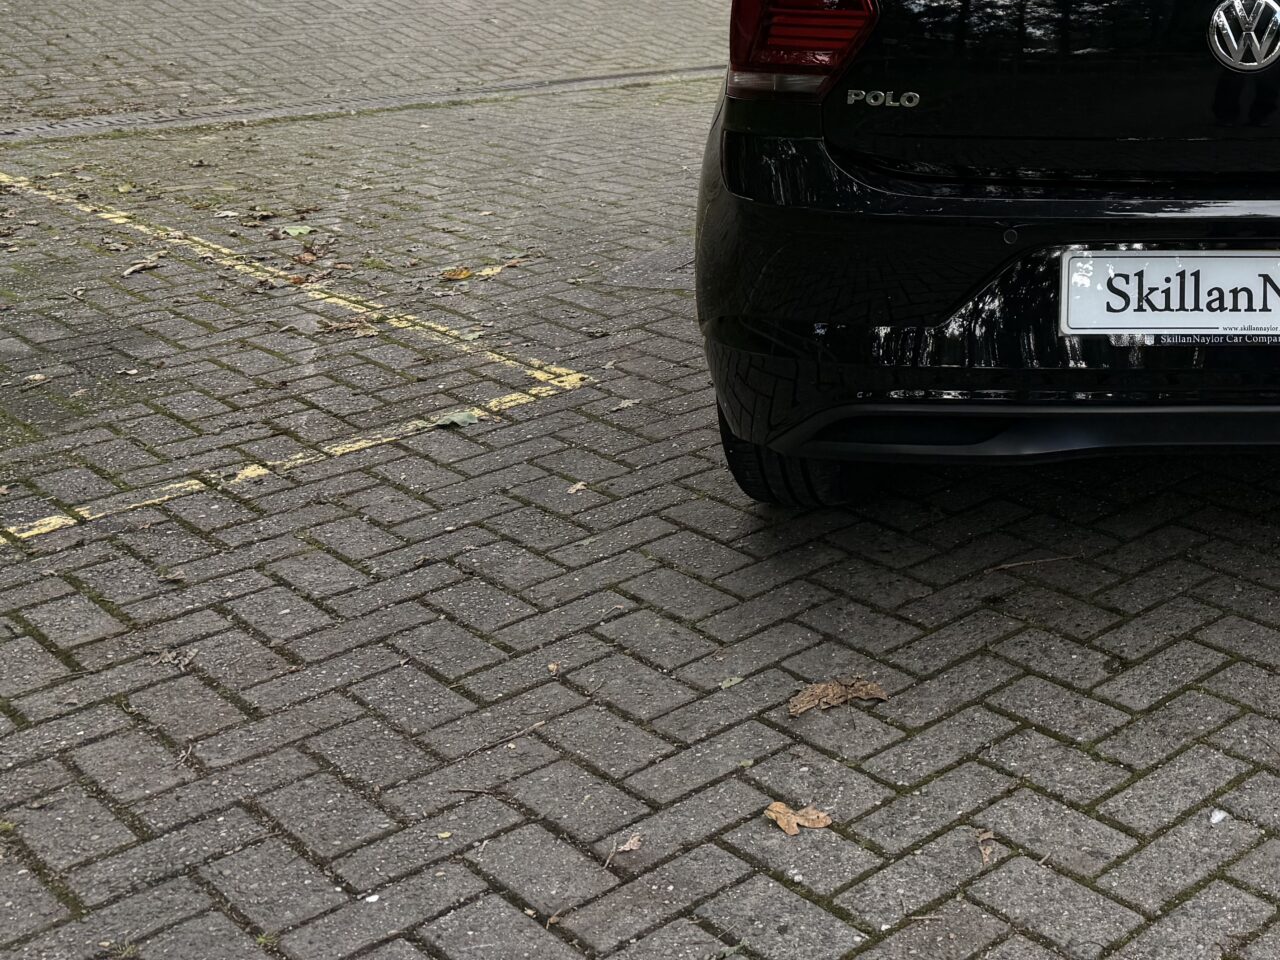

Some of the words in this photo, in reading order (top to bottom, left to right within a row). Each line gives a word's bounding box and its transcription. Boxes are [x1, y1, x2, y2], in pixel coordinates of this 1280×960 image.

[847, 89, 920, 108] POLO
[1160, 334, 1223, 344] SkillanNaylor
[1226, 334, 1243, 343] Car
